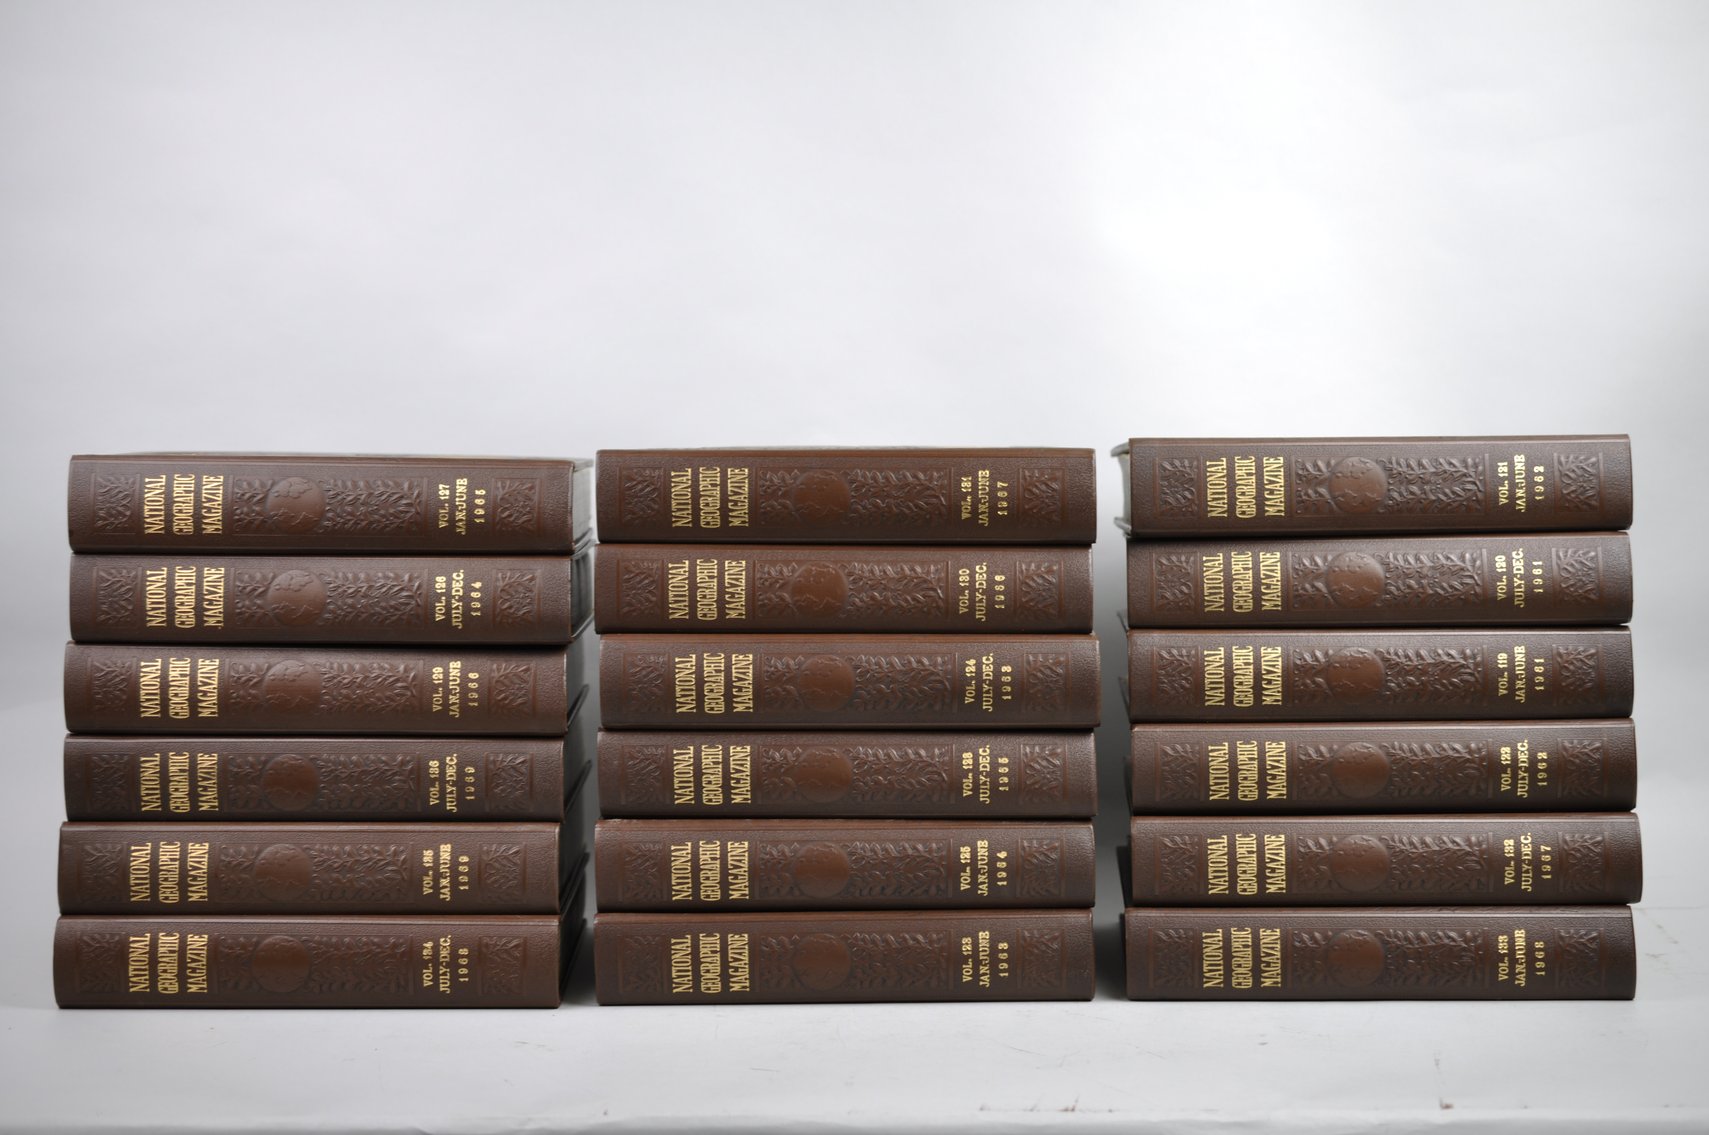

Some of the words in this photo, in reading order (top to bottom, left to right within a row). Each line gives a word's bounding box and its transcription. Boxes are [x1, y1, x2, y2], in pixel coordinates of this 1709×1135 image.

[438, 484, 450, 501] 127
[671, 468, 692, 527] NATIONAL
[699, 467, 720, 528] GEOGRAPHIC
[727, 467, 749, 526] MAGAZINE
[961, 476, 972, 492] 131
[995, 481, 1008, 515] 1967
[1206, 457, 1229, 517] NATIONAL
[1233, 456, 1258, 518] GEOGRAPHIC
[1263, 456, 1286, 516] MAGAZINE
[1499, 461, 1509, 477] 121
[1499, 479, 1509, 504] VOL.
[1534, 466, 1545, 500] 1962
[144, 475, 167, 533] NATIONAL
[172, 475, 195, 534] GEOGRAPHIC
[201, 475, 224, 533] MAGAZINE
[438, 507, 450, 528] VOL.
[474, 488, 486, 522] 1965
[961, 495, 972, 519] VOL.
[435, 576, 446, 593] 126
[667, 560, 689, 619] NATIONAL
[696, 559, 719, 620] GEOGRAPHIC
[724, 560, 747, 618] MAGAZINE
[958, 568, 971, 588] 130
[975, 561, 988, 620] JULY-DEC.
[993, 574, 1007, 608] 1966
[1201, 552, 1224, 611] NATIONAL
[1231, 550, 1254, 612] GEOGRAPHIC
[1259, 551, 1282, 610] MAGAZINE
[1495, 554, 1508, 573] 120
[1497, 576, 1508, 600] VOL.
[1513, 547, 1528, 607] JULY-DEC.
[1532, 561, 1544, 592] 1961
[145, 568, 168, 626] NATIONAL
[175, 565, 196, 628] GEOGRAPHIC
[203, 567, 224, 626] MAGAZINE
[435, 597, 446, 621] VOL.
[451, 570, 464, 628] JULY-DEC.
[470, 581, 481, 616] 1964
[958, 590, 971, 613] VOL.
[140, 659, 163, 717] NATIONAL
[167, 657, 191, 718] GEOGRAPHIC
[197, 659, 220, 716] MAGAZINE
[432, 666, 444, 684] 129
[466, 672, 480, 706] 1966
[674, 654, 697, 712] NATIONAL
[703, 652, 725, 713] GEOGRAPHIC
[732, 652, 753, 712] MAGAZINE
[965, 657, 977, 677] 124
[980, 653, 997, 712] JULY-DEC.
[1001, 665, 1013, 699] 1963
[1202, 647, 1226, 706] NATIONAL
[1232, 645, 1255, 707] GEOGRAPHIC
[1261, 646, 1283, 704] MAGAZINE
[1497, 652, 1509, 669] 119
[1497, 672, 1509, 695] VOL.
[432, 688, 444, 711] VOL.
[965, 680, 977, 703] VOL.
[141, 753, 161, 810] NATIONAL
[168, 752, 190, 812] GEOGRAPHIC
[196, 753, 218, 810] MAGAZINE
[428, 760, 440, 778] 136
[445, 754, 457, 812] JULY-DEC.
[464, 767, 475, 799] 1969
[673, 745, 695, 804] NATIONAL
[701, 744, 723, 805] GEOGRAPHIC
[728, 745, 752, 803] MAGAZINE
[962, 752, 974, 769] 128
[978, 744, 992, 803] JULY-DEC.
[996, 757, 1009, 791] 1965
[1208, 742, 1230, 800] NATIONAL
[1236, 741, 1259, 801] GEOGRAPHIC
[1264, 740, 1287, 799] MAGAZINE
[1499, 745, 1512, 764] 122
[1499, 768, 1512, 791] VOL.
[1517, 739, 1530, 797] JULY-DEC.
[1536, 752, 1550, 785] 1962
[428, 782, 440, 805] VOL.
[962, 772, 974, 796] VOL.
[128, 842, 152, 900] NATIONAL
[158, 841, 181, 903] GEOGRAPHIC
[187, 842, 209, 901] MAGAZINE
[422, 848, 434, 867] 135
[458, 855, 471, 890] 1969
[671, 842, 692, 900] NATIONAL
[699, 839, 721, 901] GEOGRAPHIC
[727, 840, 749, 899] MAGAZINE
[960, 845, 971, 863] 125
[993, 848, 1008, 886] 1964
[1207, 835, 1229, 894] NATIONAL
[1235, 832, 1258, 895] GEOGRAPHIC
[1264, 833, 1286, 893] MAGAZINE
[1504, 839, 1515, 857] 132
[1504, 861, 1515, 884] VOL.
[1520, 833, 1533, 891] JULY-DEC.
[1540, 845, 1552, 879] 1967
[422, 870, 434, 894] VOL.
[960, 867, 971, 890] VOL.
[129, 933, 151, 992] NATIONAL
[158, 932, 180, 993] GEOGRAPHIC
[187, 934, 208, 992] MAGAZINE
[423, 941, 434, 959] 134
[439, 934, 451, 992] JULY-DEC.
[458, 948, 468, 981] 1968
[671, 935, 692, 993] NATIONAL
[699, 933, 721, 993] GEOGRAPHIC
[728, 934, 750, 991] MAGAZINE
[961, 937, 973, 955] 123
[961, 959, 973, 982] VOL.
[998, 942, 1008, 976] 1963
[1202, 929, 1223, 987] NATIONAL
[1231, 928, 1252, 988] GEOGRAPHIC
[1260, 928, 1281, 987] MAGAZINE
[1498, 935, 1509, 953] 133
[1498, 957, 1509, 980] VOL.
[1535, 941, 1545, 975] 1968
[423, 964, 434, 986] VOL.
